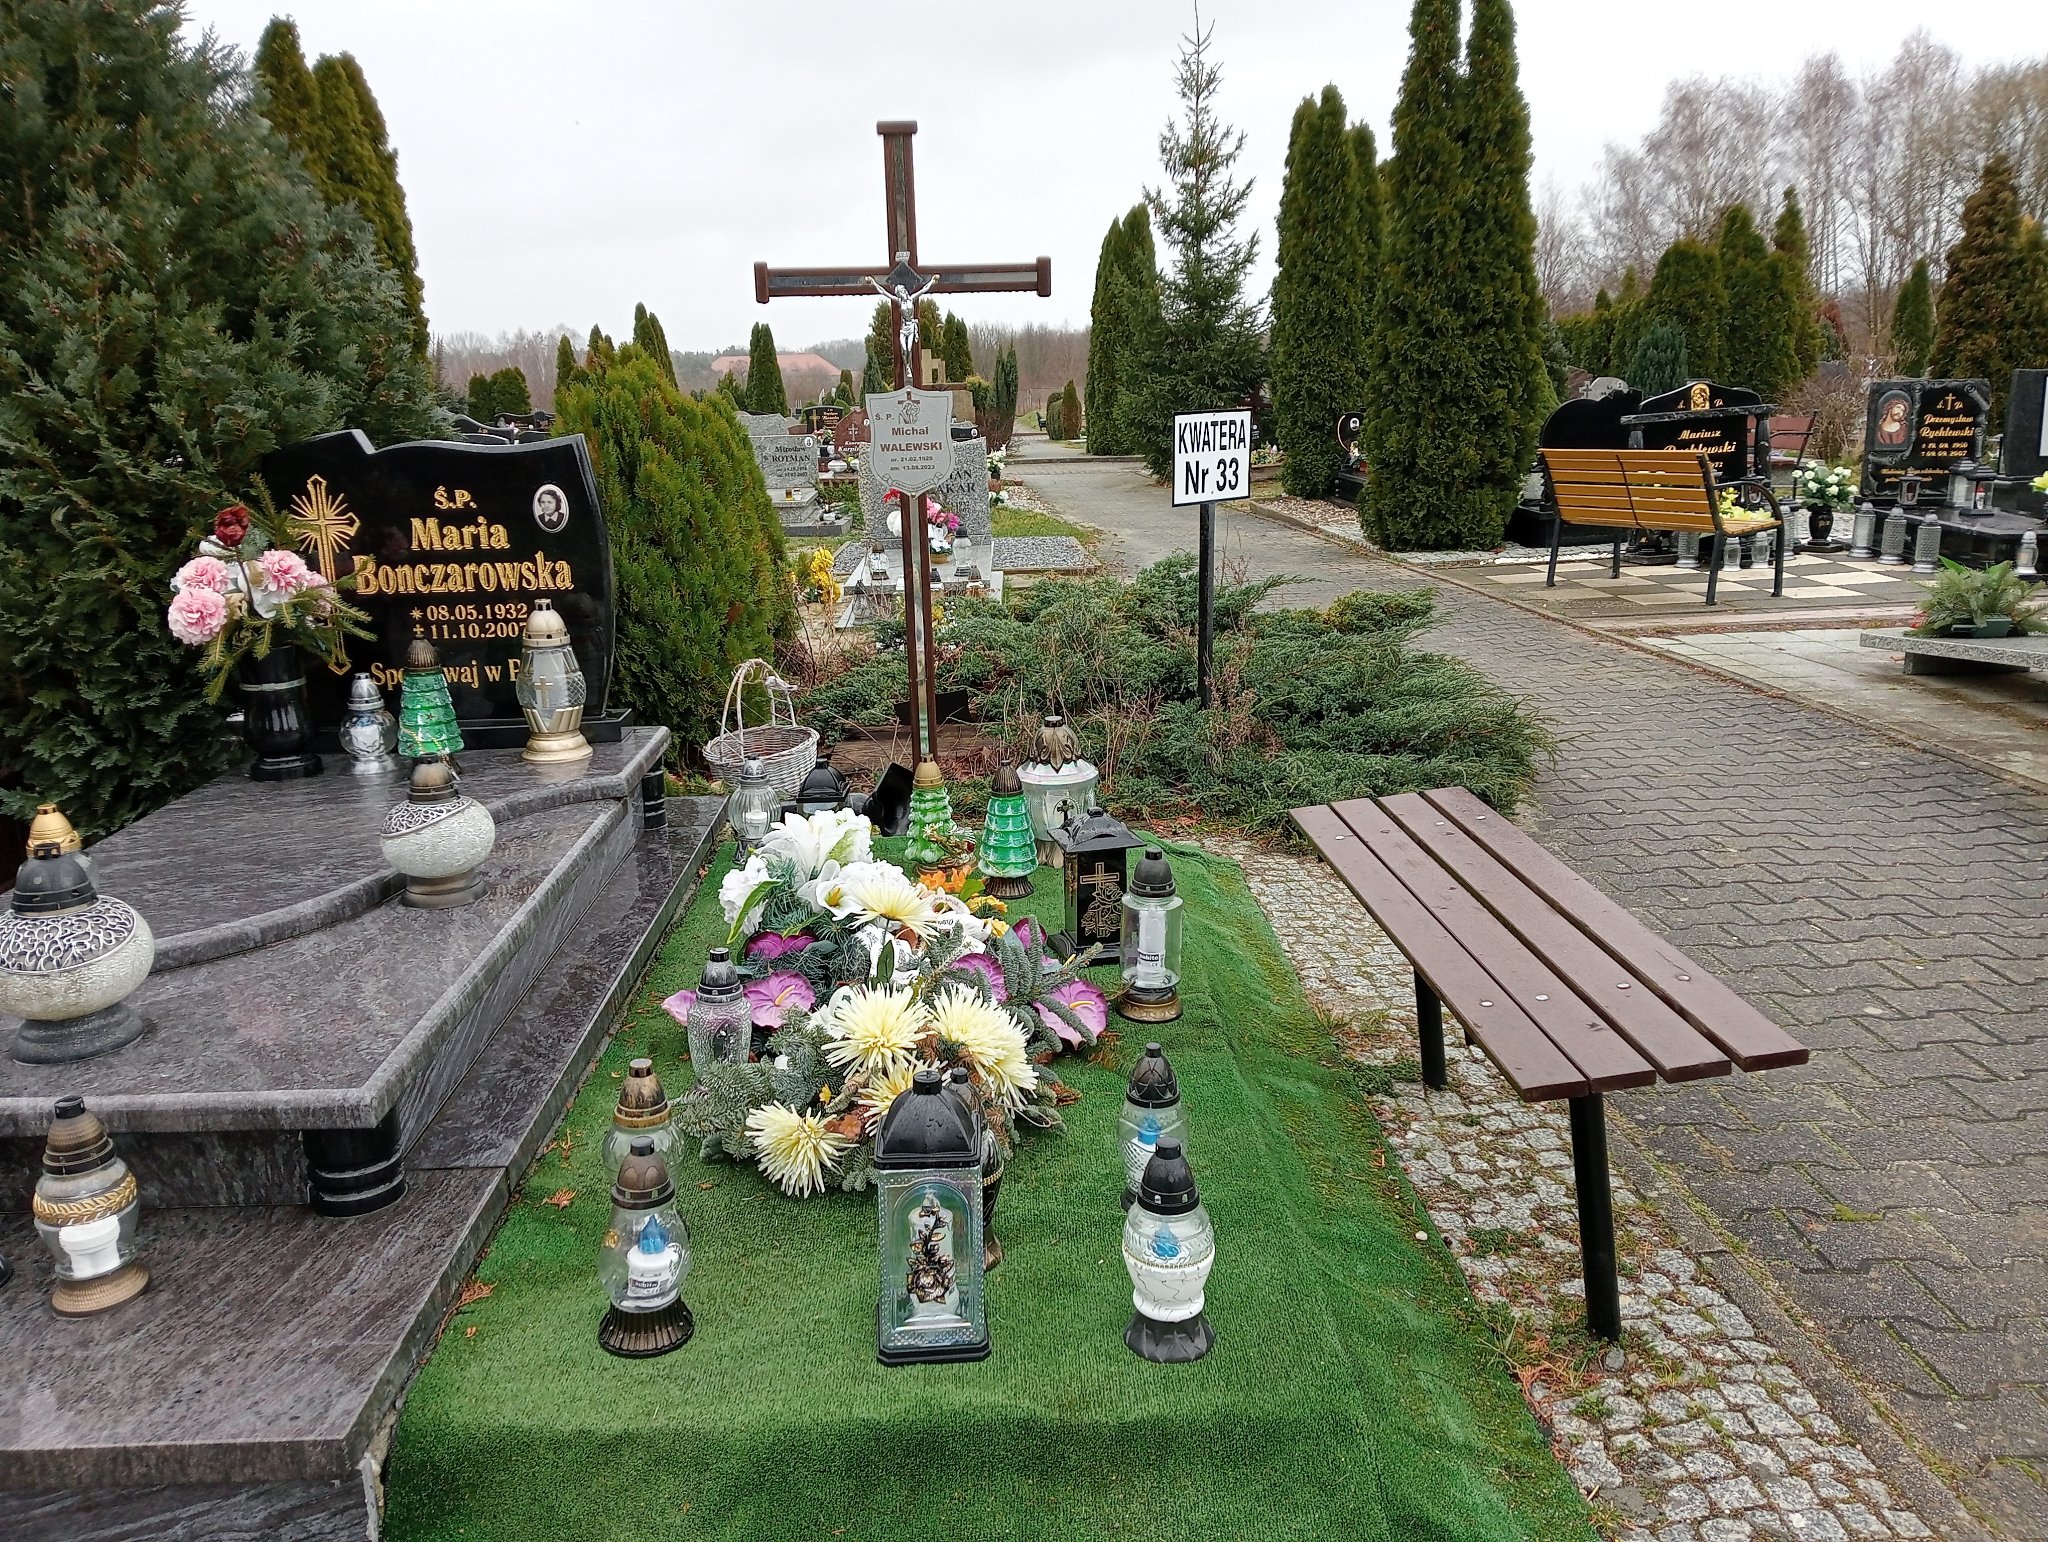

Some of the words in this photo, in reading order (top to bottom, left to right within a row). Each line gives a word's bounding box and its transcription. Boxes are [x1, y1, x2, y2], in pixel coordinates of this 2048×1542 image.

[1178, 419, 1247, 454] KWATERA
[1677, 428, 1722, 441] Mariusz
[880, 441, 943, 453] WALEWSKI
[1663, 441, 1737, 454] hlewski
[771, 454, 811, 462] ROTMAN
[1185, 460, 1209, 496] Nr
[1216, 457, 1239, 492] 33
[434, 485, 478, 510] Ś.P.
[410, 516, 511, 550] Maria
[352, 550, 573, 594] Bonczarowska
[426, 603, 529, 622] 08.05.1932
[430, 622, 527, 640] 11.10.2007
[484, 665, 502, 682] w
